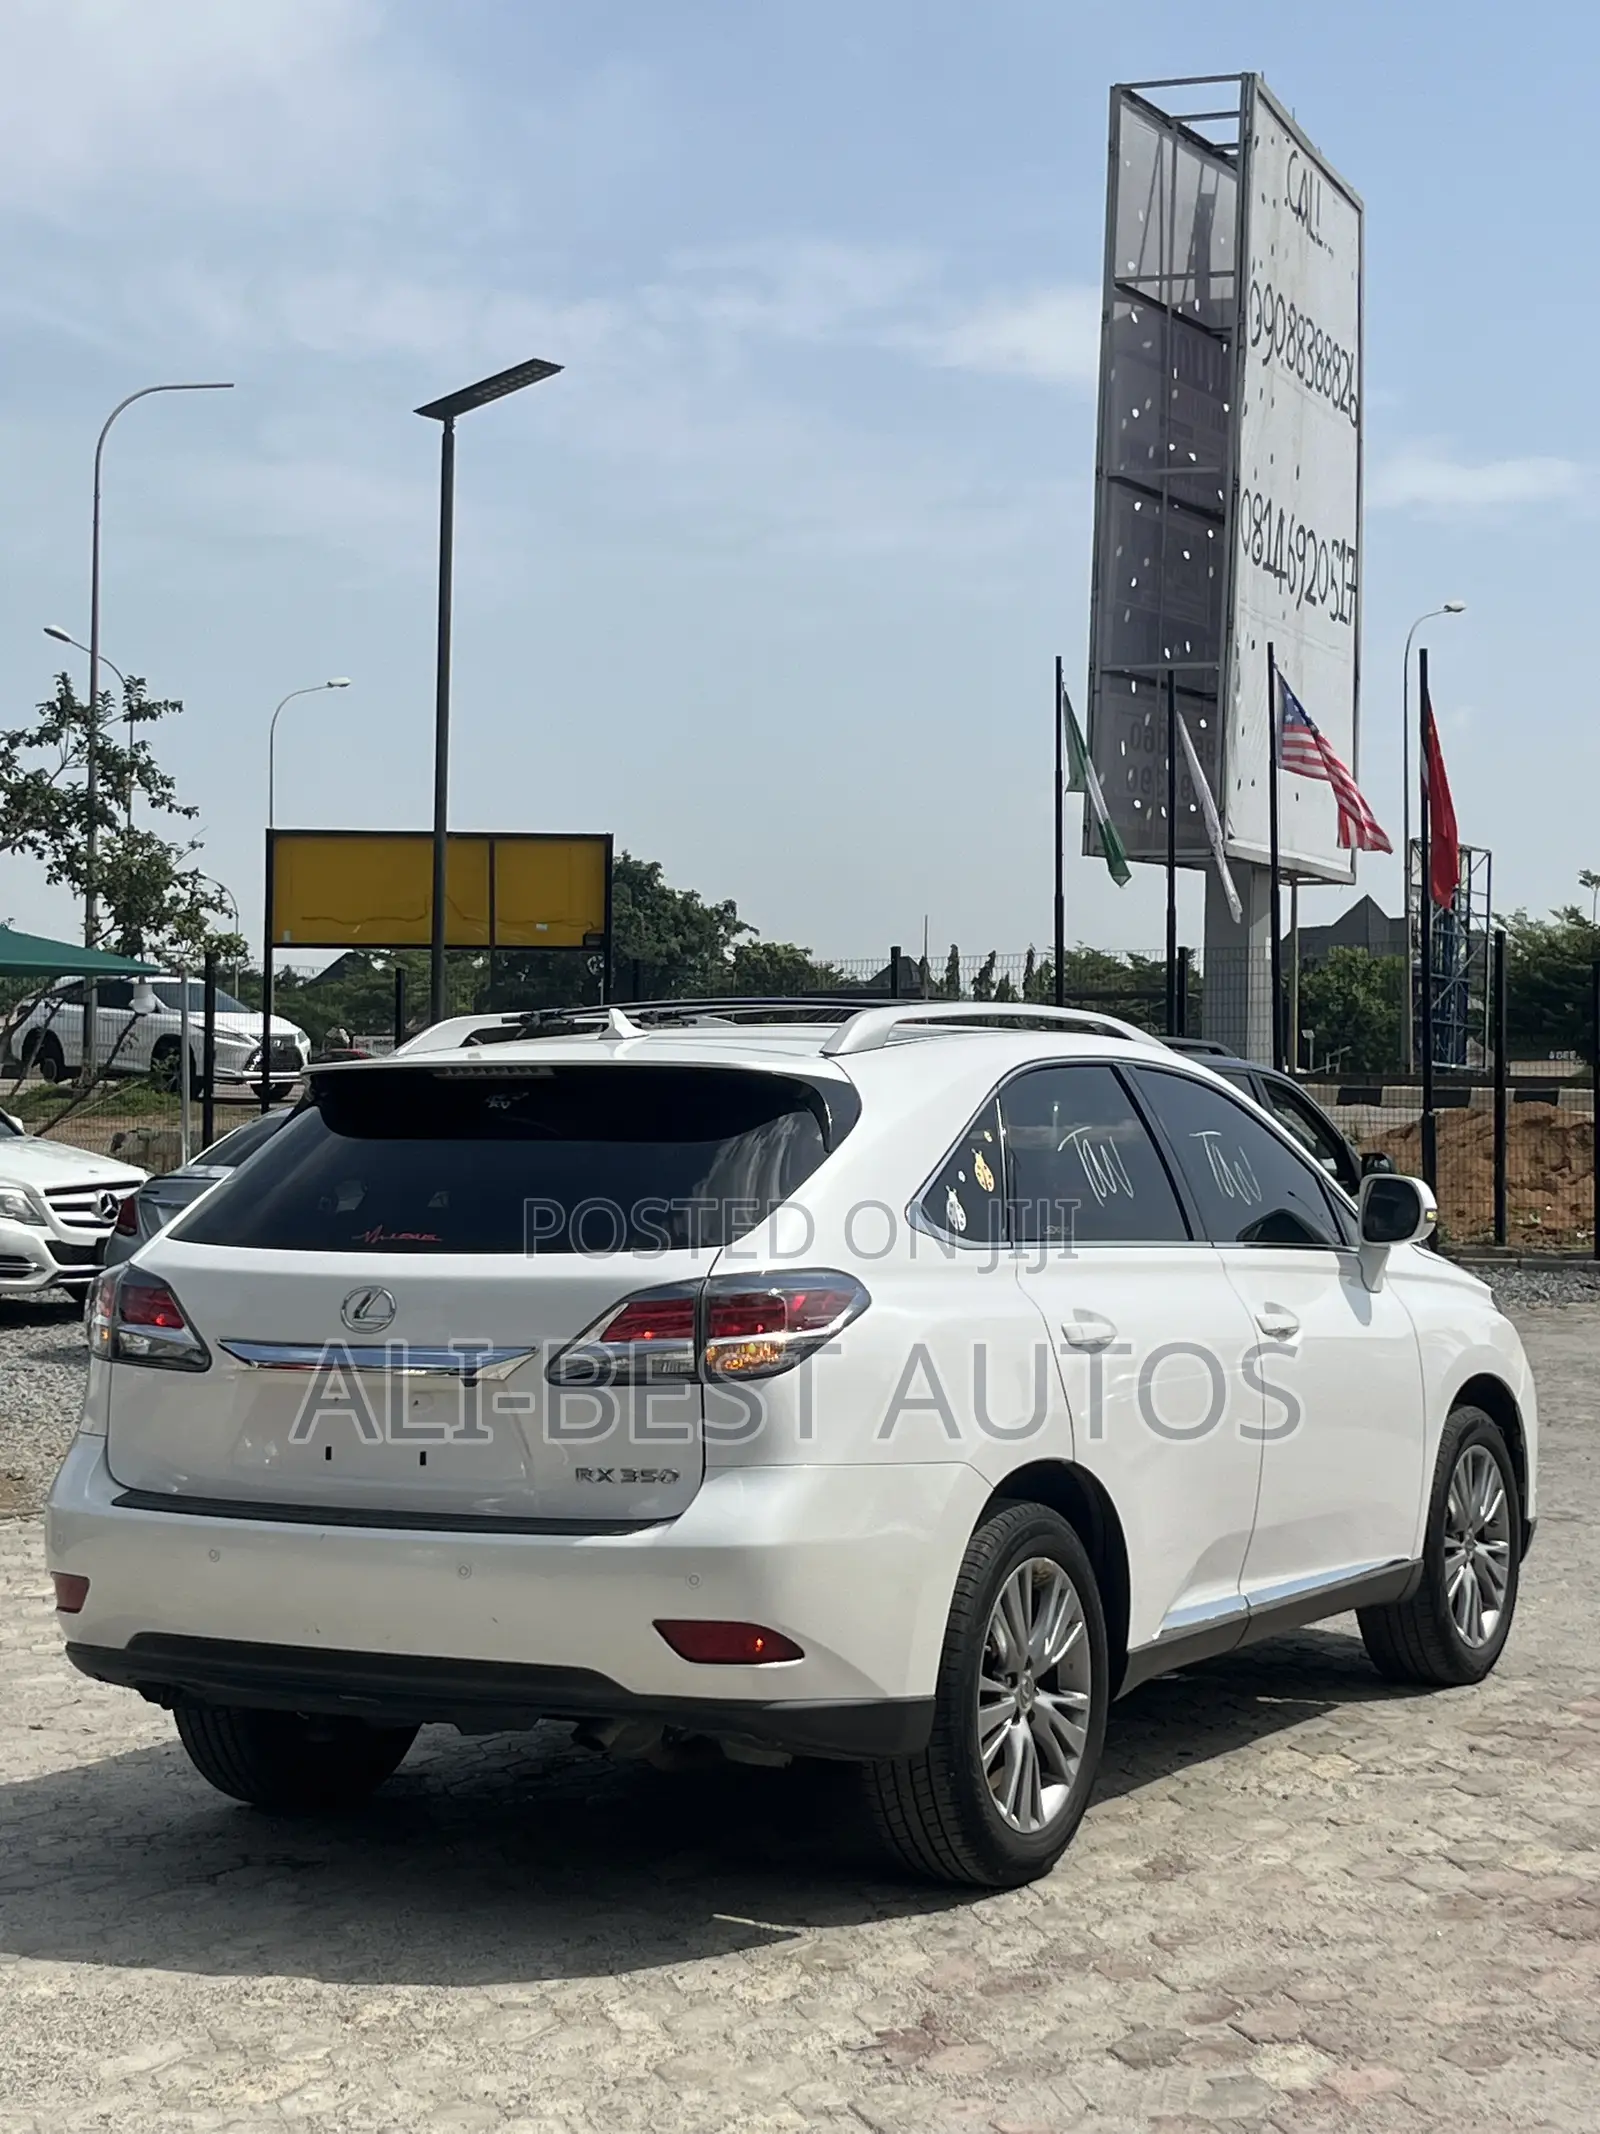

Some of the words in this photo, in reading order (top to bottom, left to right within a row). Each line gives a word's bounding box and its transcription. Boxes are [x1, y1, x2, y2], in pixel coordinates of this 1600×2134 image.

[1249, 280, 1358, 428] 09088388826
[1241, 488, 1358, 627] 08146920517
[574, 1466, 615, 1484] RX
[620, 1467, 681, 1485] 350
